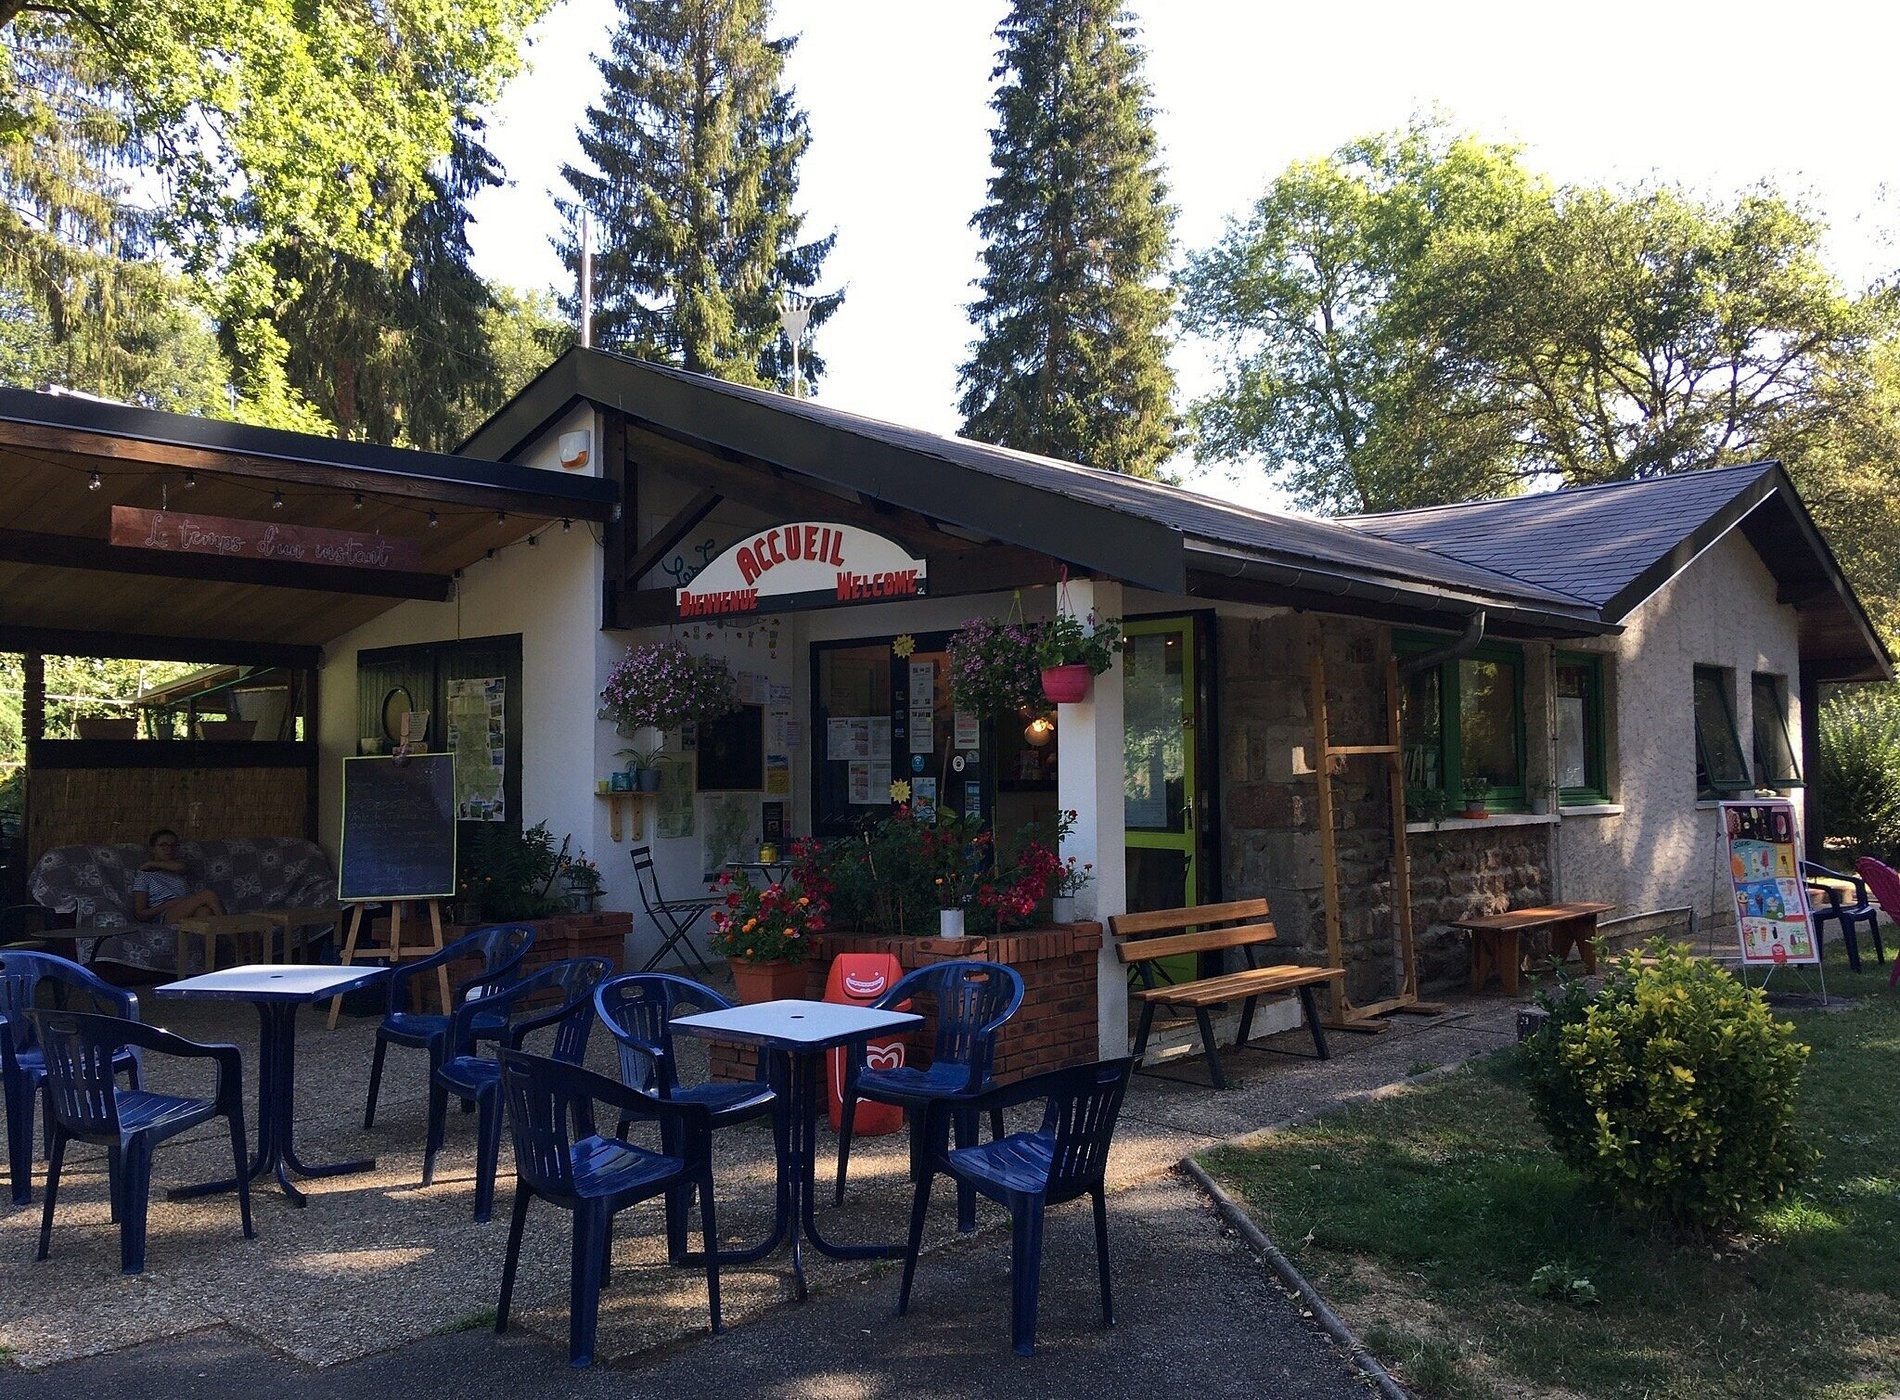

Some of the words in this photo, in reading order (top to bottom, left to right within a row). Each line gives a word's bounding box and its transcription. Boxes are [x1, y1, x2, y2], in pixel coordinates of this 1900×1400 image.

[145, 513, 168, 547] Le
[179, 518, 246, 555] temps
[257, 525, 305, 557] d'un
[314, 537, 394, 567] instant
[736, 525, 845, 586] ACCUEIL
[679, 588, 759, 617] BIENVENUE
[836, 569, 918, 601] WELCOME
